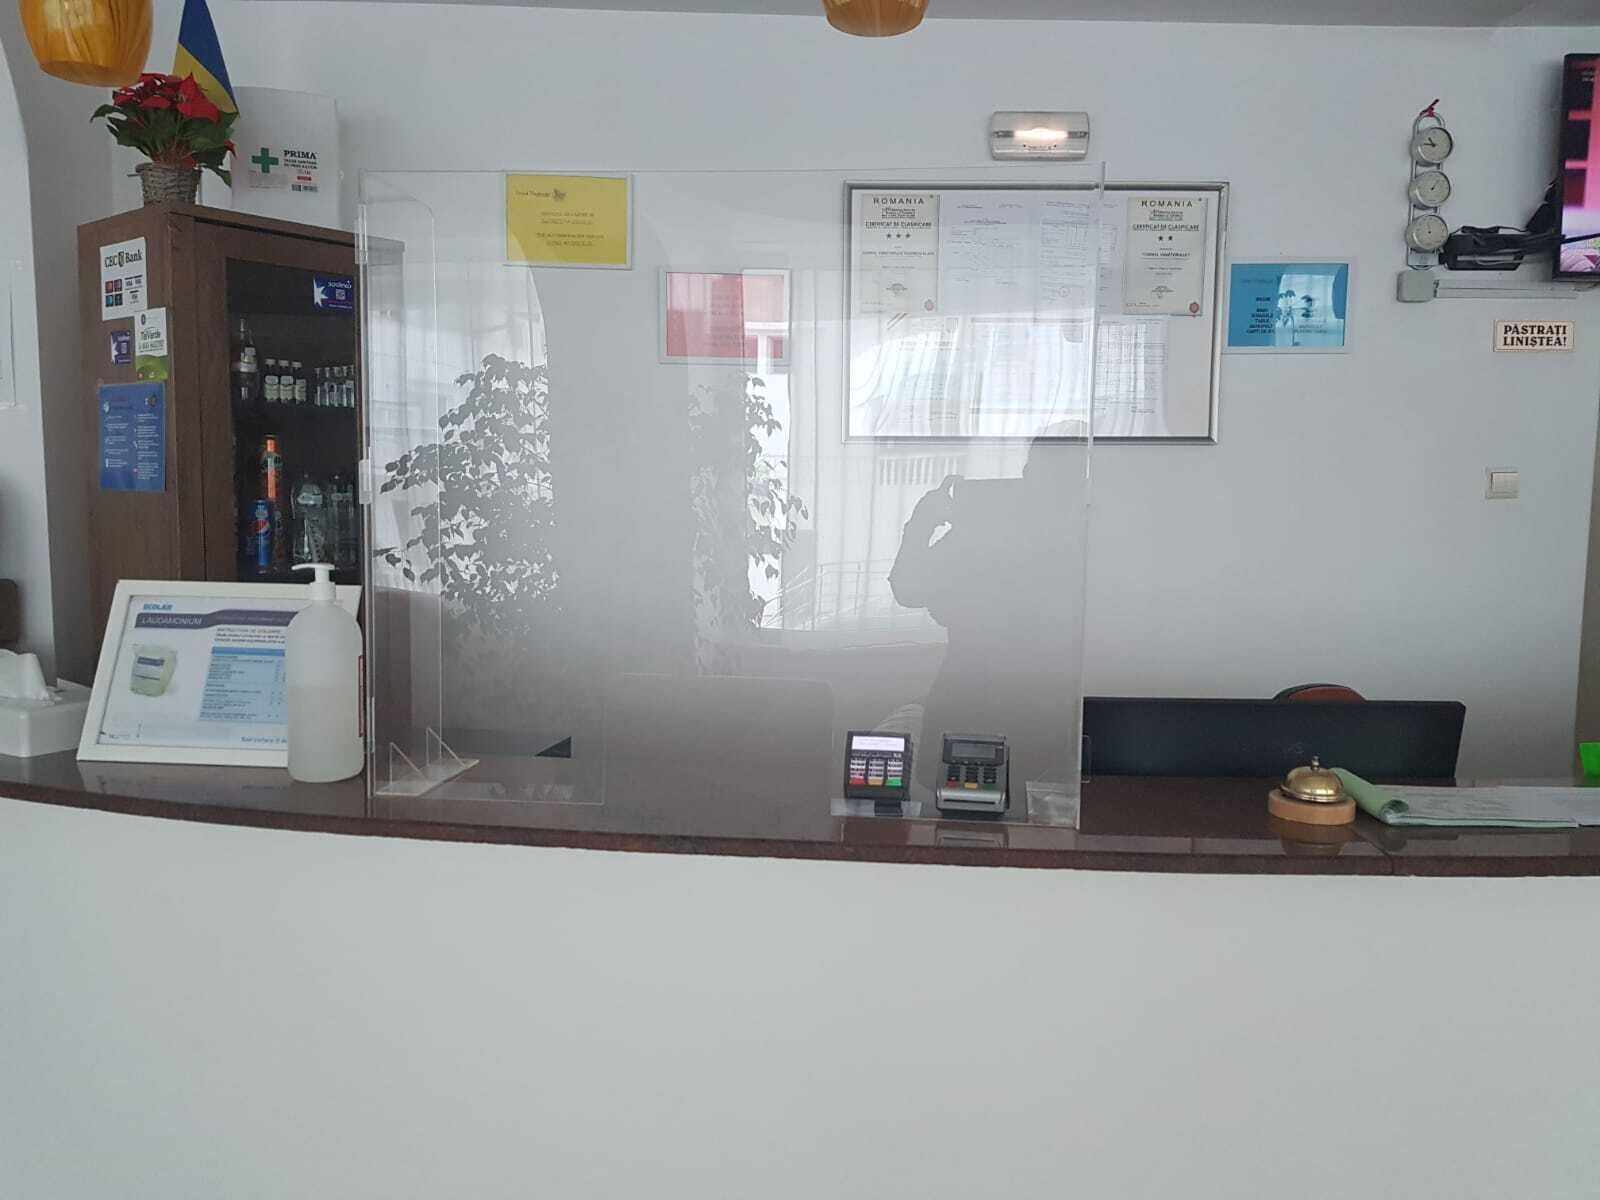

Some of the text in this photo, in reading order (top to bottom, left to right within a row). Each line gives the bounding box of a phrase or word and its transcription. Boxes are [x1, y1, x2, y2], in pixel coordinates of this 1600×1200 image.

[283, 149, 317, 160] PRIMA
[873, 197, 925, 205] ROMANIA
[1141, 199, 1193, 208] ROMANIA
[104, 249, 143, 268] CEC Bank
[141, 615, 203, 625] LAUDAMONIUM
